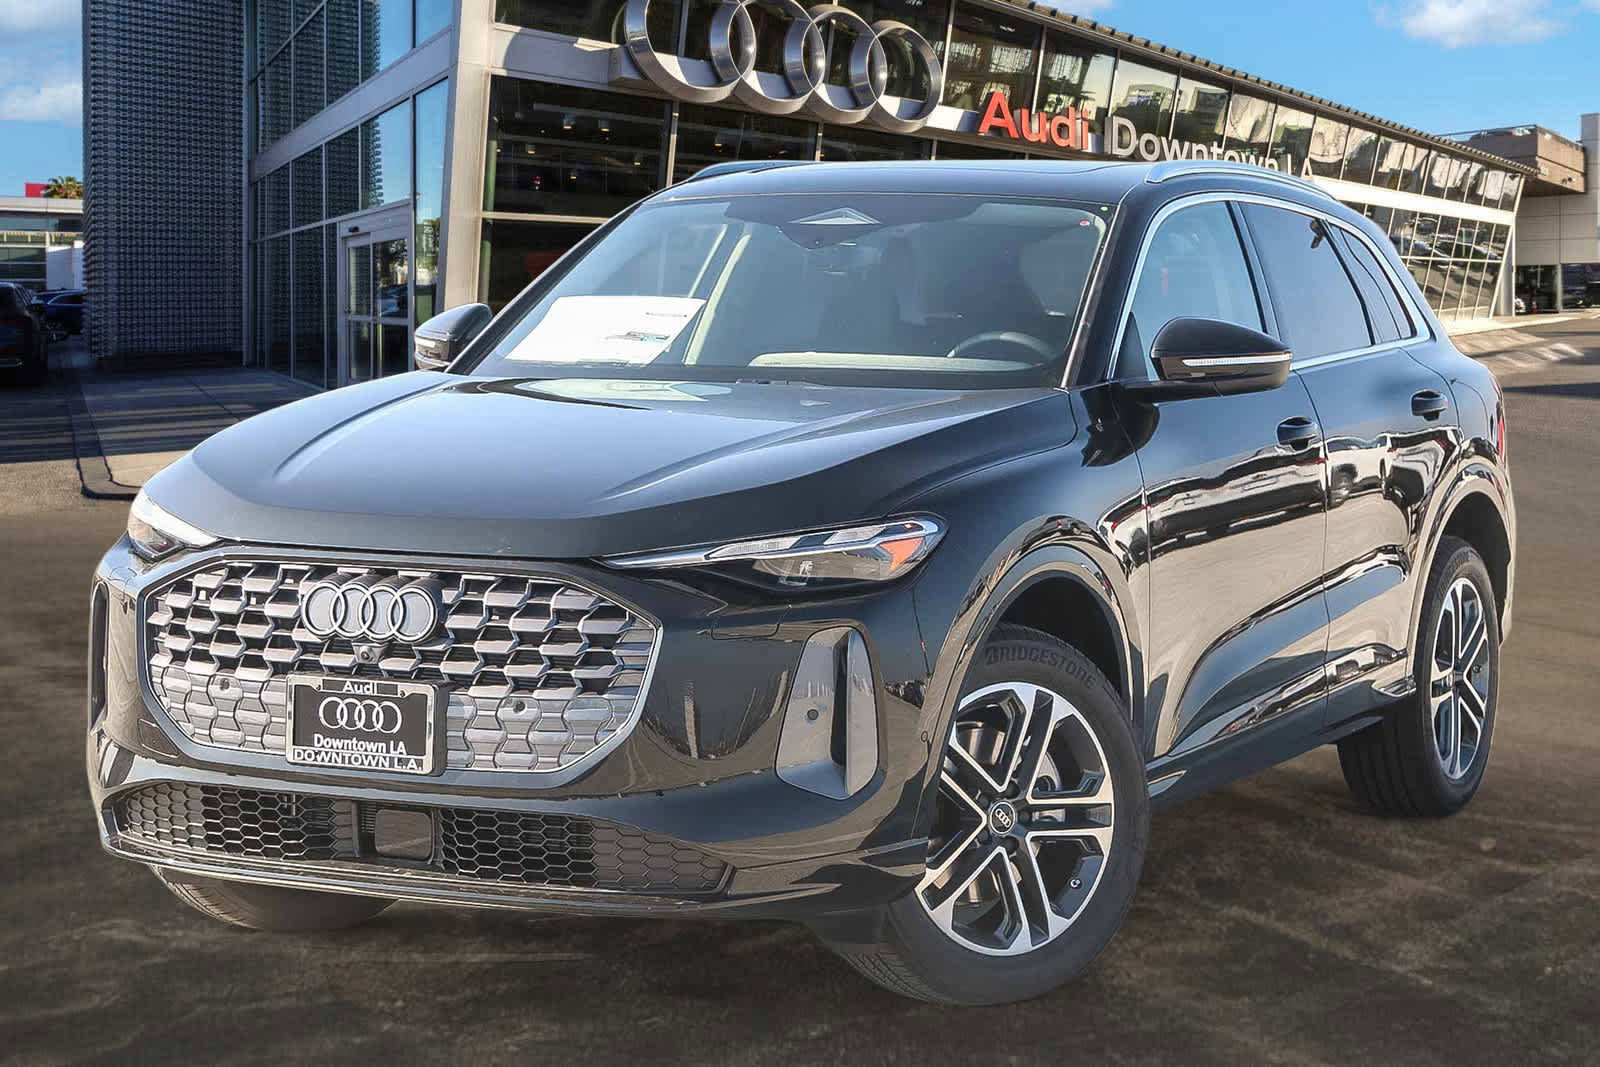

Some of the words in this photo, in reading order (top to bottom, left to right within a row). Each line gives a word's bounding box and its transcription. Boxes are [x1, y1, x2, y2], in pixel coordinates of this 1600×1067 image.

[978, 91, 1089, 150] Audi
[985, 646, 1097, 689] BRIDGESTONE
[342, 680, 377, 695] Audi
[313, 733, 387, 754] Downtown
[390, 740, 408, 755] LA
[294, 750, 392, 768] DOWNTOWN
[394, 756, 423, 771] L.A.
